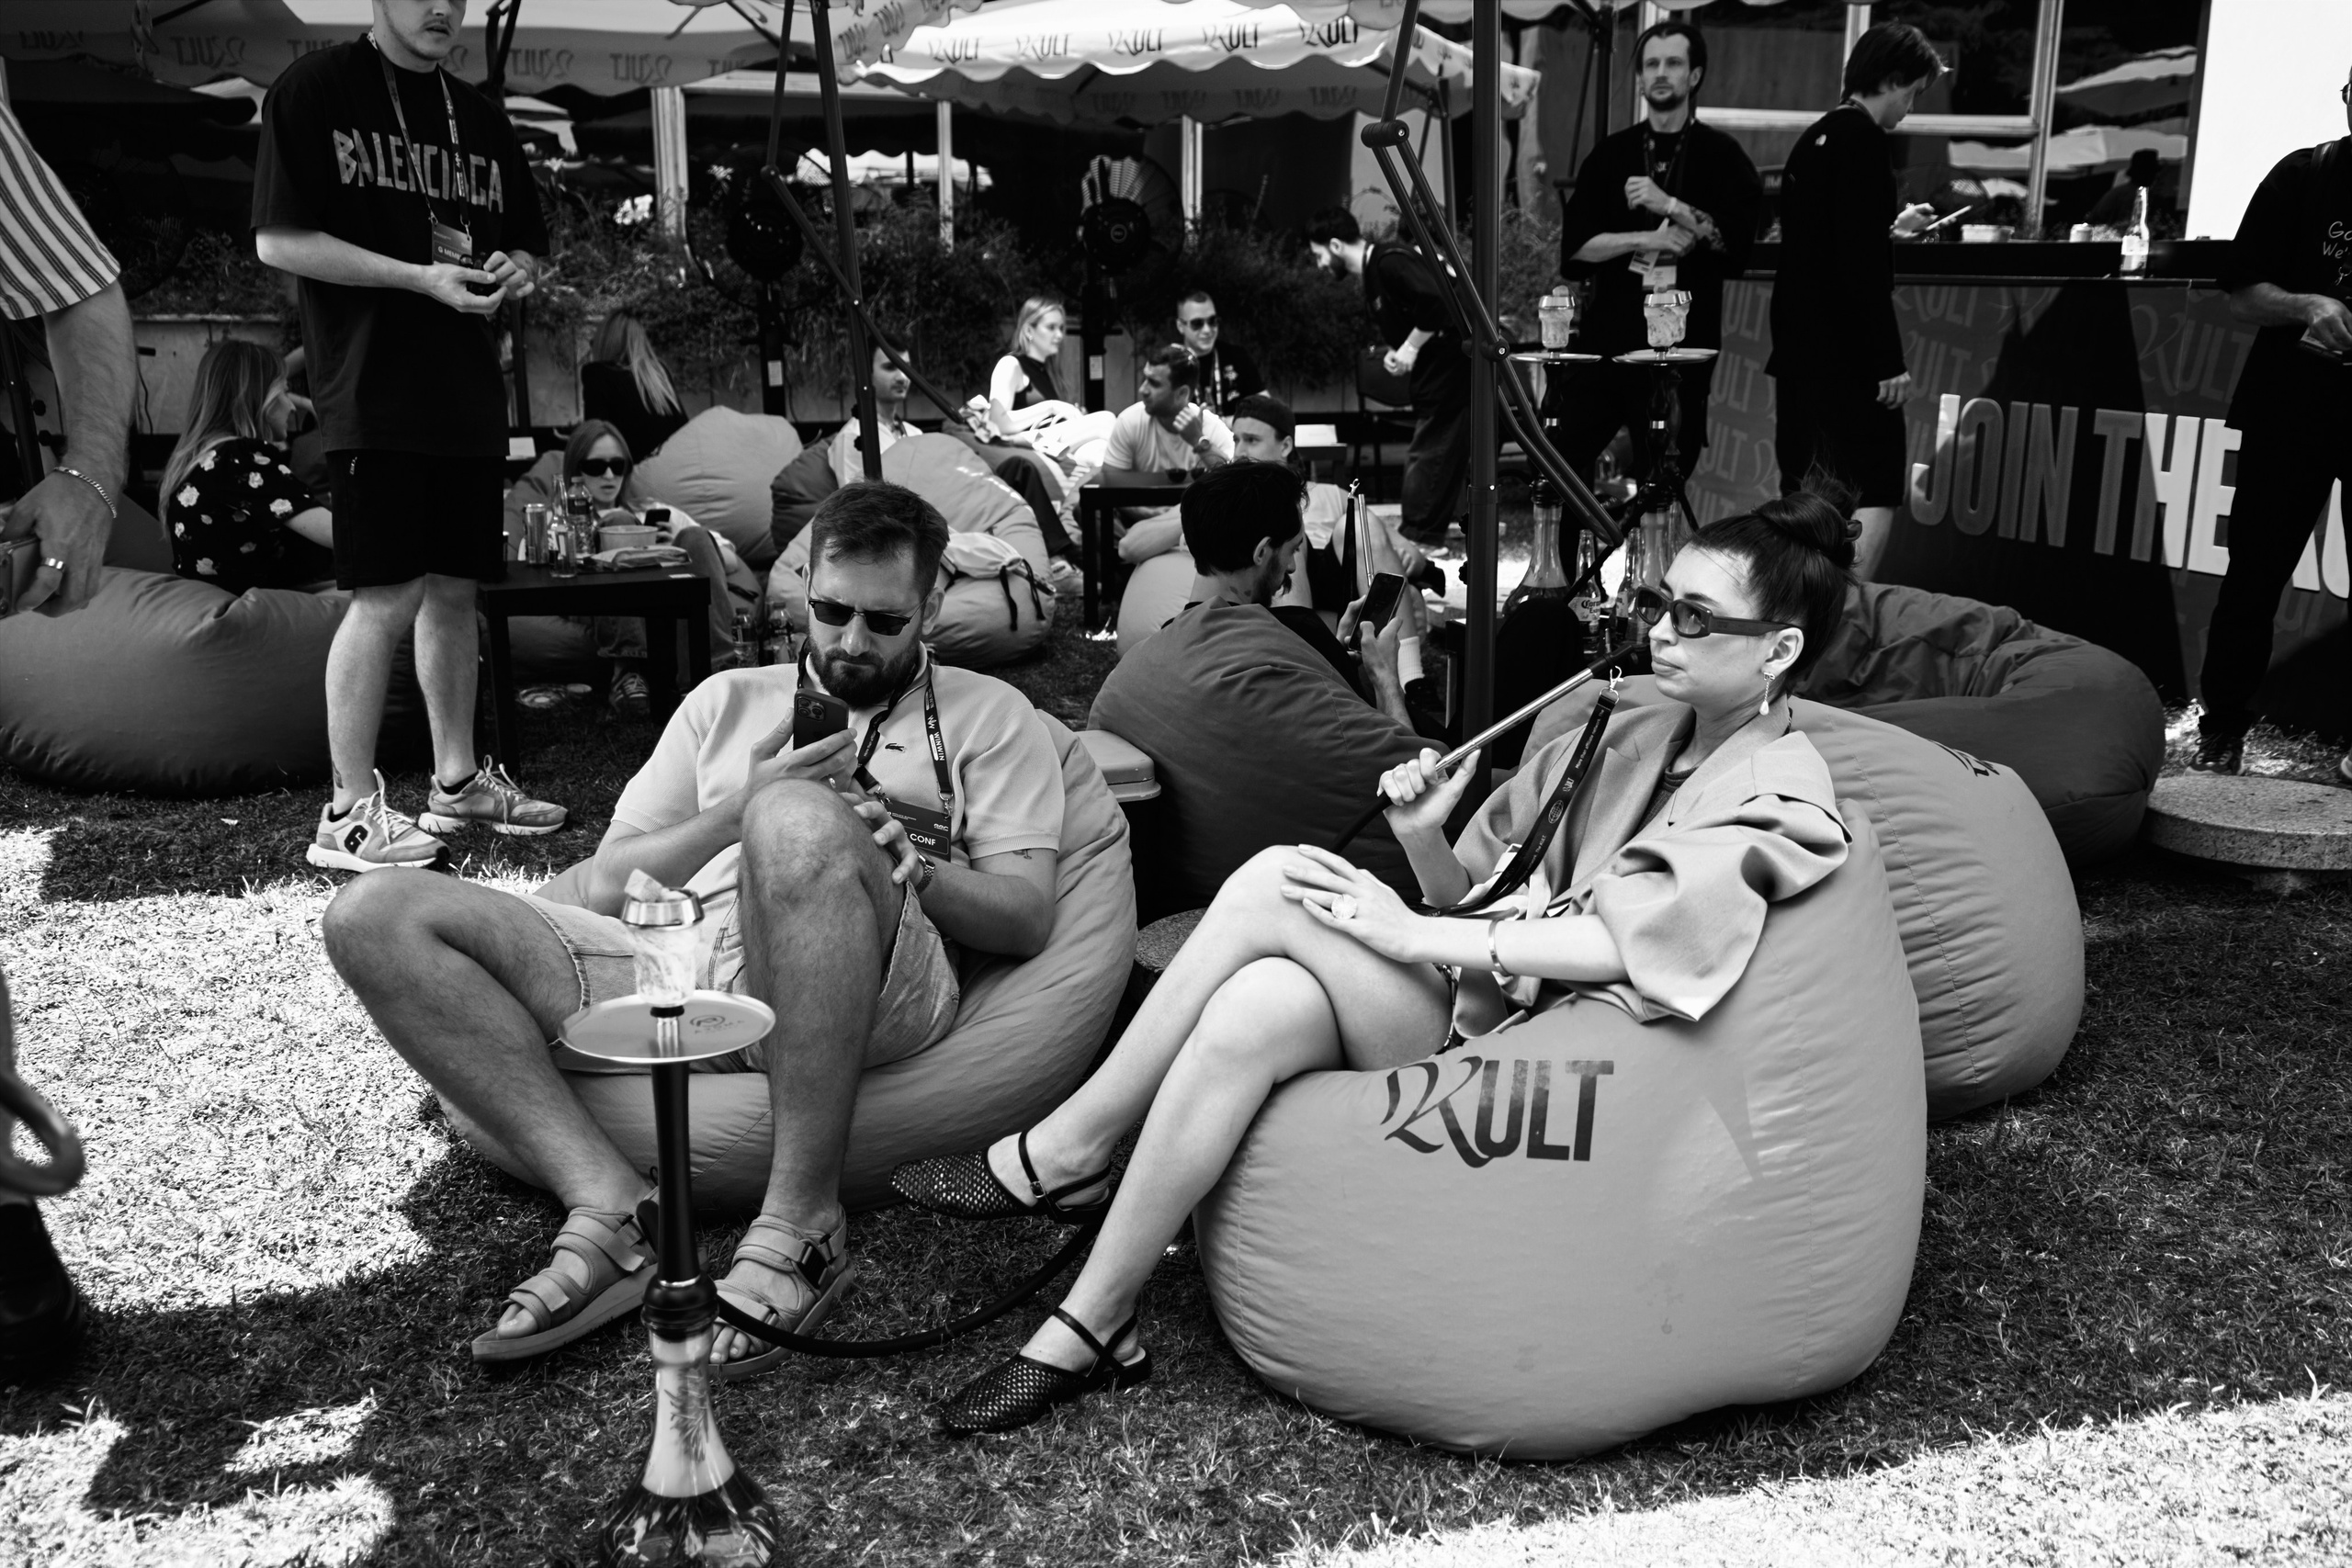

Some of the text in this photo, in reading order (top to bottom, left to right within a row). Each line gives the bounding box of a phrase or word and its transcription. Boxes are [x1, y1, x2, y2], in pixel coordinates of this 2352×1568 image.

[1721, 280, 1772, 342] ULT
[1708, 351, 1761, 412] ULT
[1699, 418, 1748, 482] ULT
[1910, 393, 2079, 548] JOIN
[2094, 408, 2243, 577] THE
[933, 731, 945, 761] WINWIN
[910, 833, 936, 846] CONF
[1380, 1055, 1614, 1168] KULT
